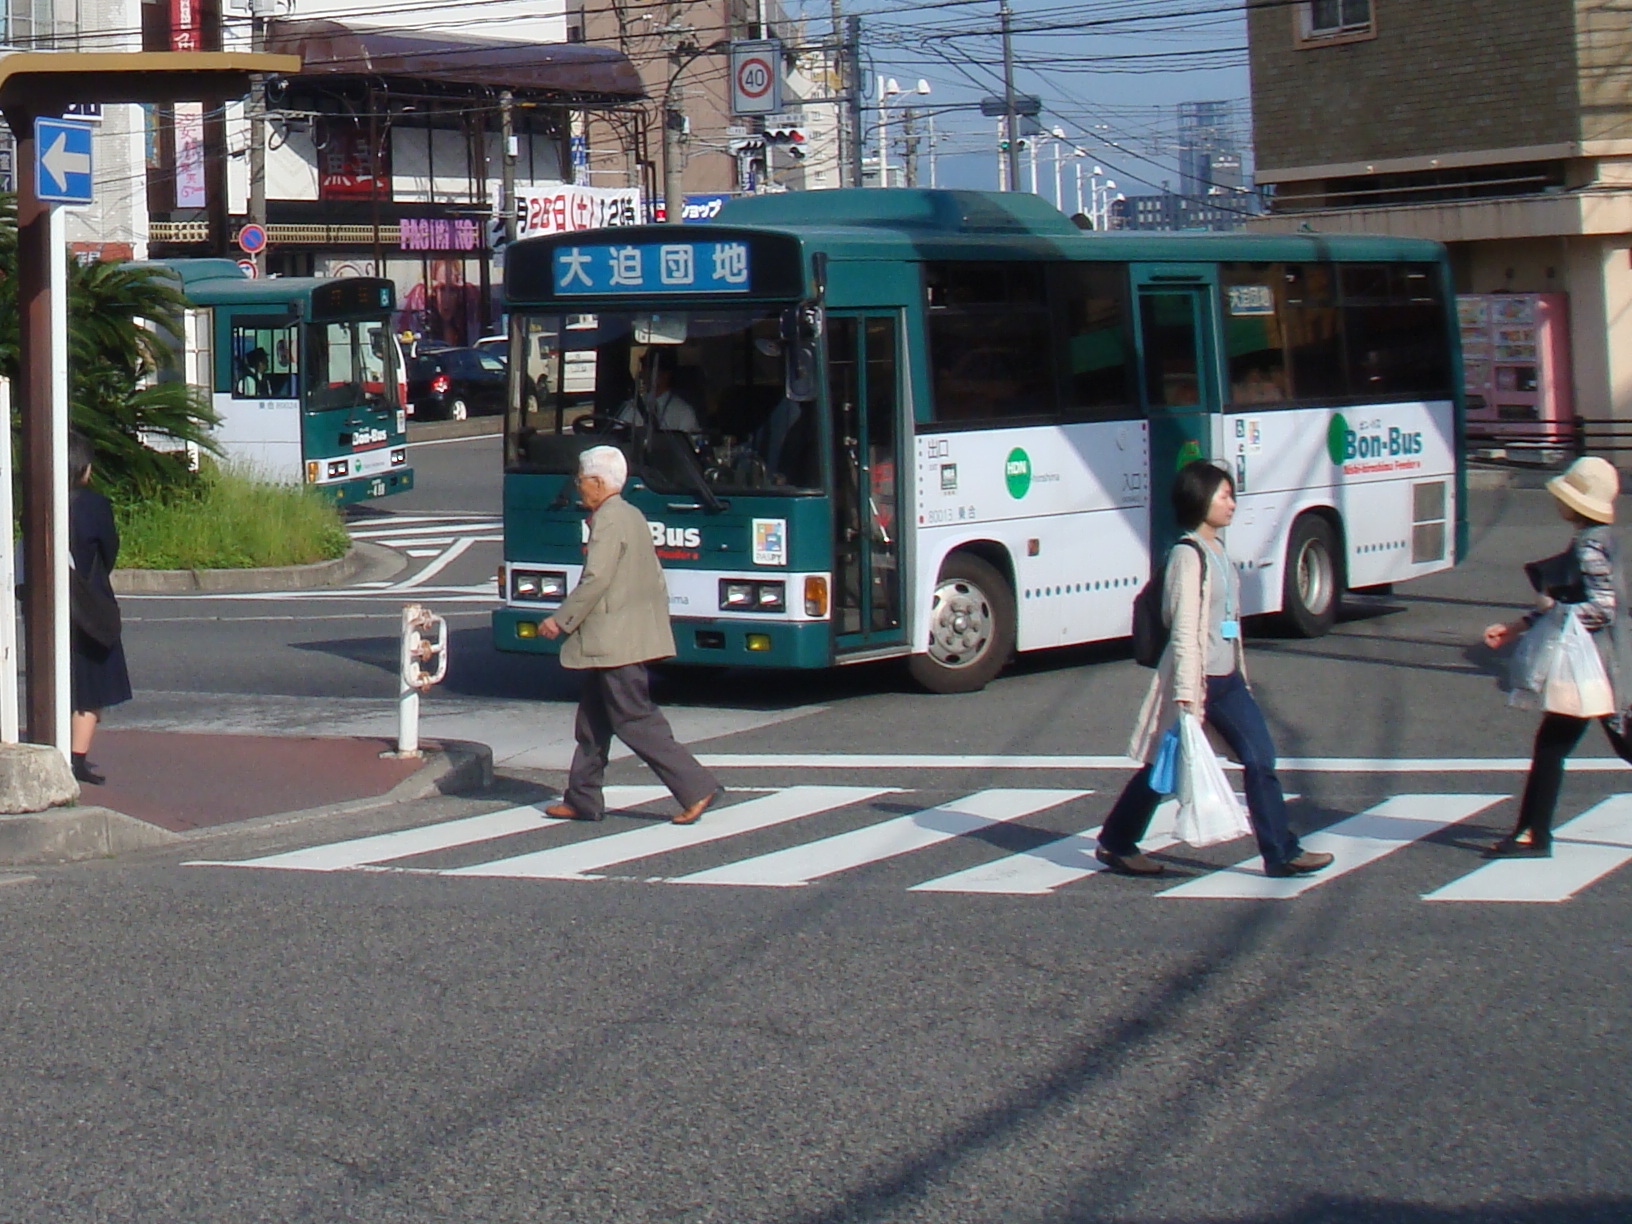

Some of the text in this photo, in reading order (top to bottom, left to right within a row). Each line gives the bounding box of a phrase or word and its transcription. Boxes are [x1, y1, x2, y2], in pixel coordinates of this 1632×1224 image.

[744, 68, 765, 88] 40
[558, 245, 749, 288] 大迫団地
[928, 438, 949, 460] 出口
[1343, 426, 1423, 460] Bon-Bus
[1006, 460, 1027, 476] HDN
